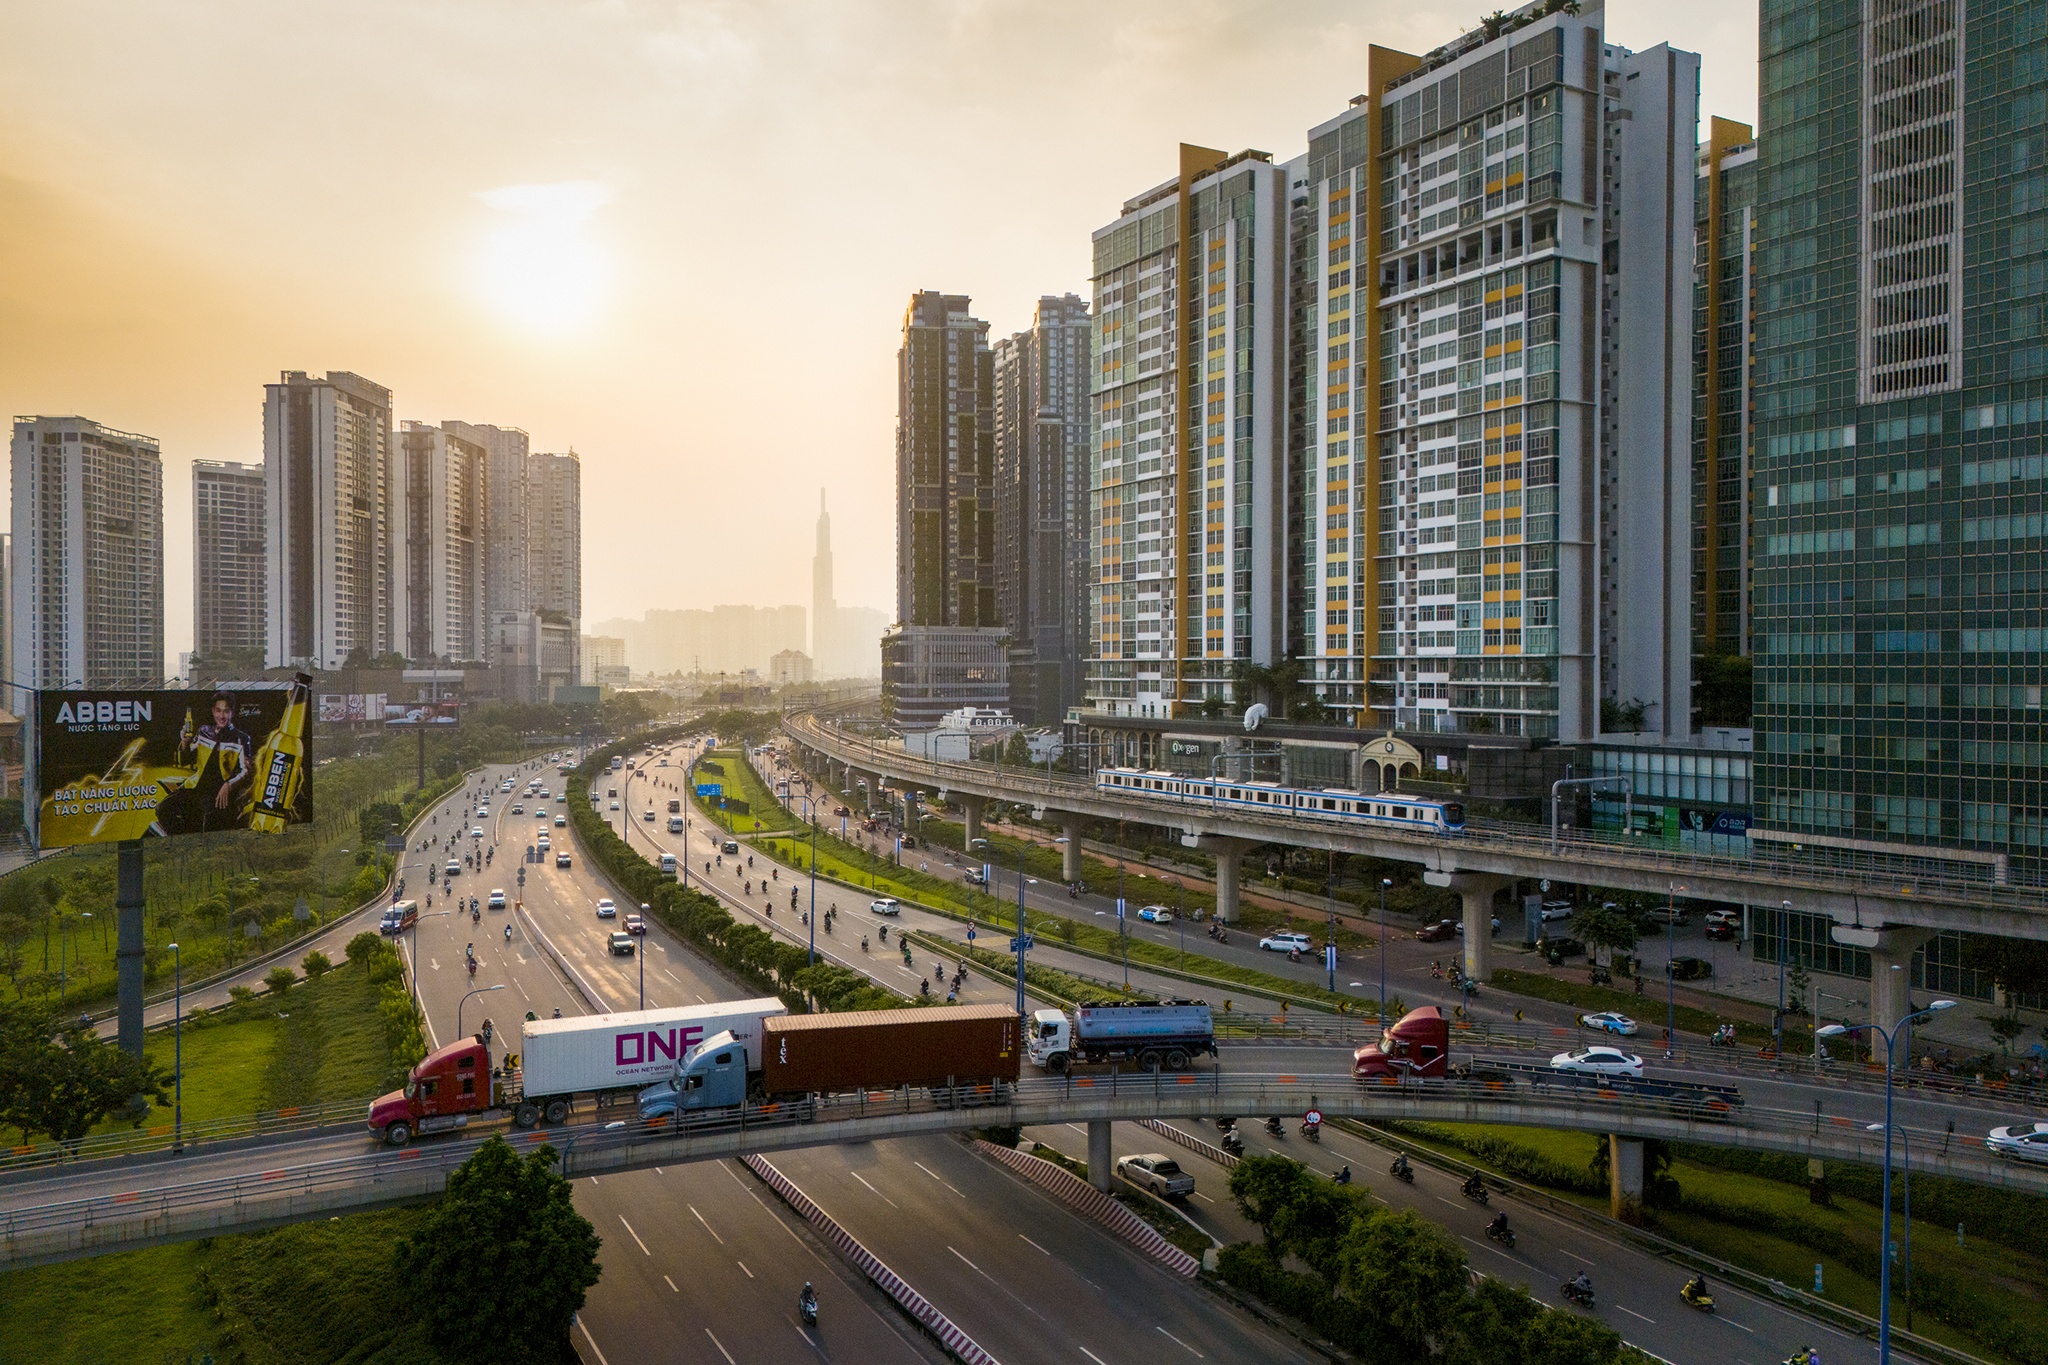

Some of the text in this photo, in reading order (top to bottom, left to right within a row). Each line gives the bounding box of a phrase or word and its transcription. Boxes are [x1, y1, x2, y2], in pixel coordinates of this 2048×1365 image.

[55, 700, 152, 723] ABBEN
[263, 752, 286, 809] ABBEN
[54, 804, 80, 818] TẠO
[779, 1037, 787, 1064] tex
[616, 1064, 673, 1076] OCEAN NETWORK
